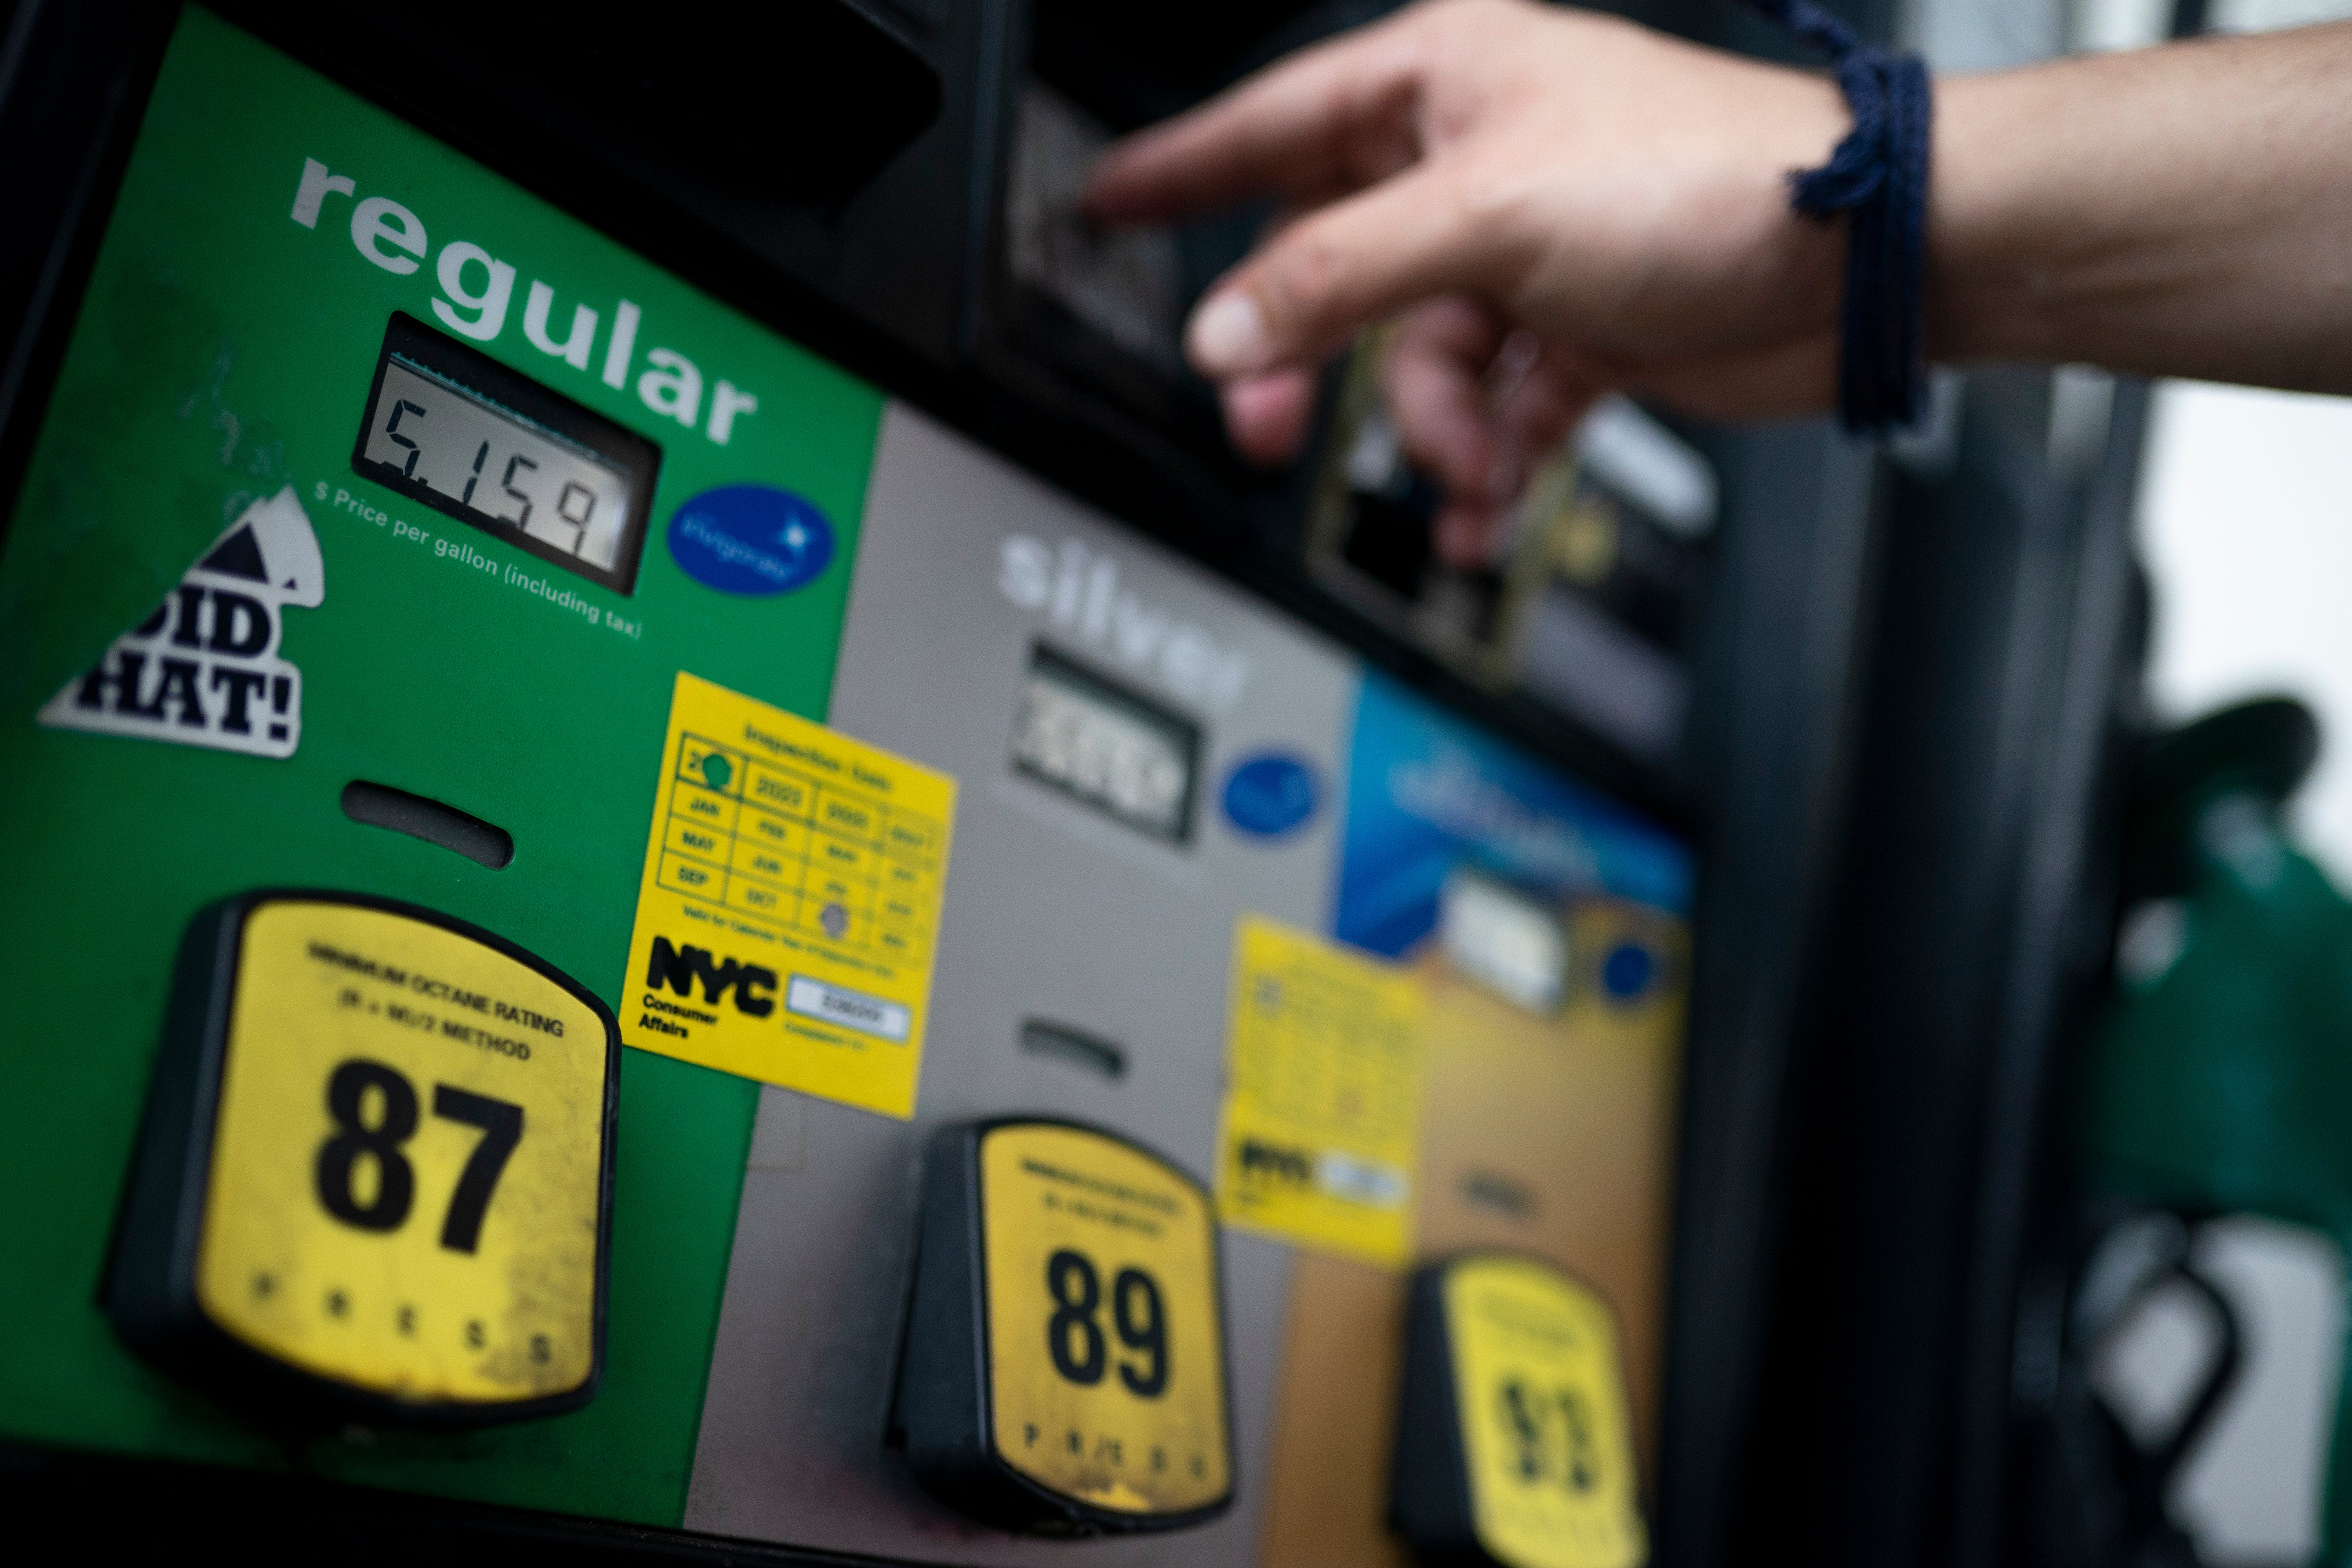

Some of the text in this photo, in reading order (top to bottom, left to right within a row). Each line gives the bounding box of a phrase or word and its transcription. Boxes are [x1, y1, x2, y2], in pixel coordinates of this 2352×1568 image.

[290, 157, 757, 445] regular
[315, 481, 642, 640] $ Price per gallon (including tax)
[998, 535, 1246, 706] silver
[691, 797, 720, 816] JAN
[682, 831, 715, 852] MAY
[679, 866, 708, 886] SEP
[412, 975, 490, 1015] OCTANE
[494, 1001, 564, 1038] RATING
[647, 935, 778, 1019] NYC
[440, 1020, 532, 1062] METHOD
[639, 1013, 689, 1038] Affairs
[642, 993, 718, 1026] Consumer
[315, 1054, 524, 1256] 87
[1047, 1249, 1167, 1400] 89
